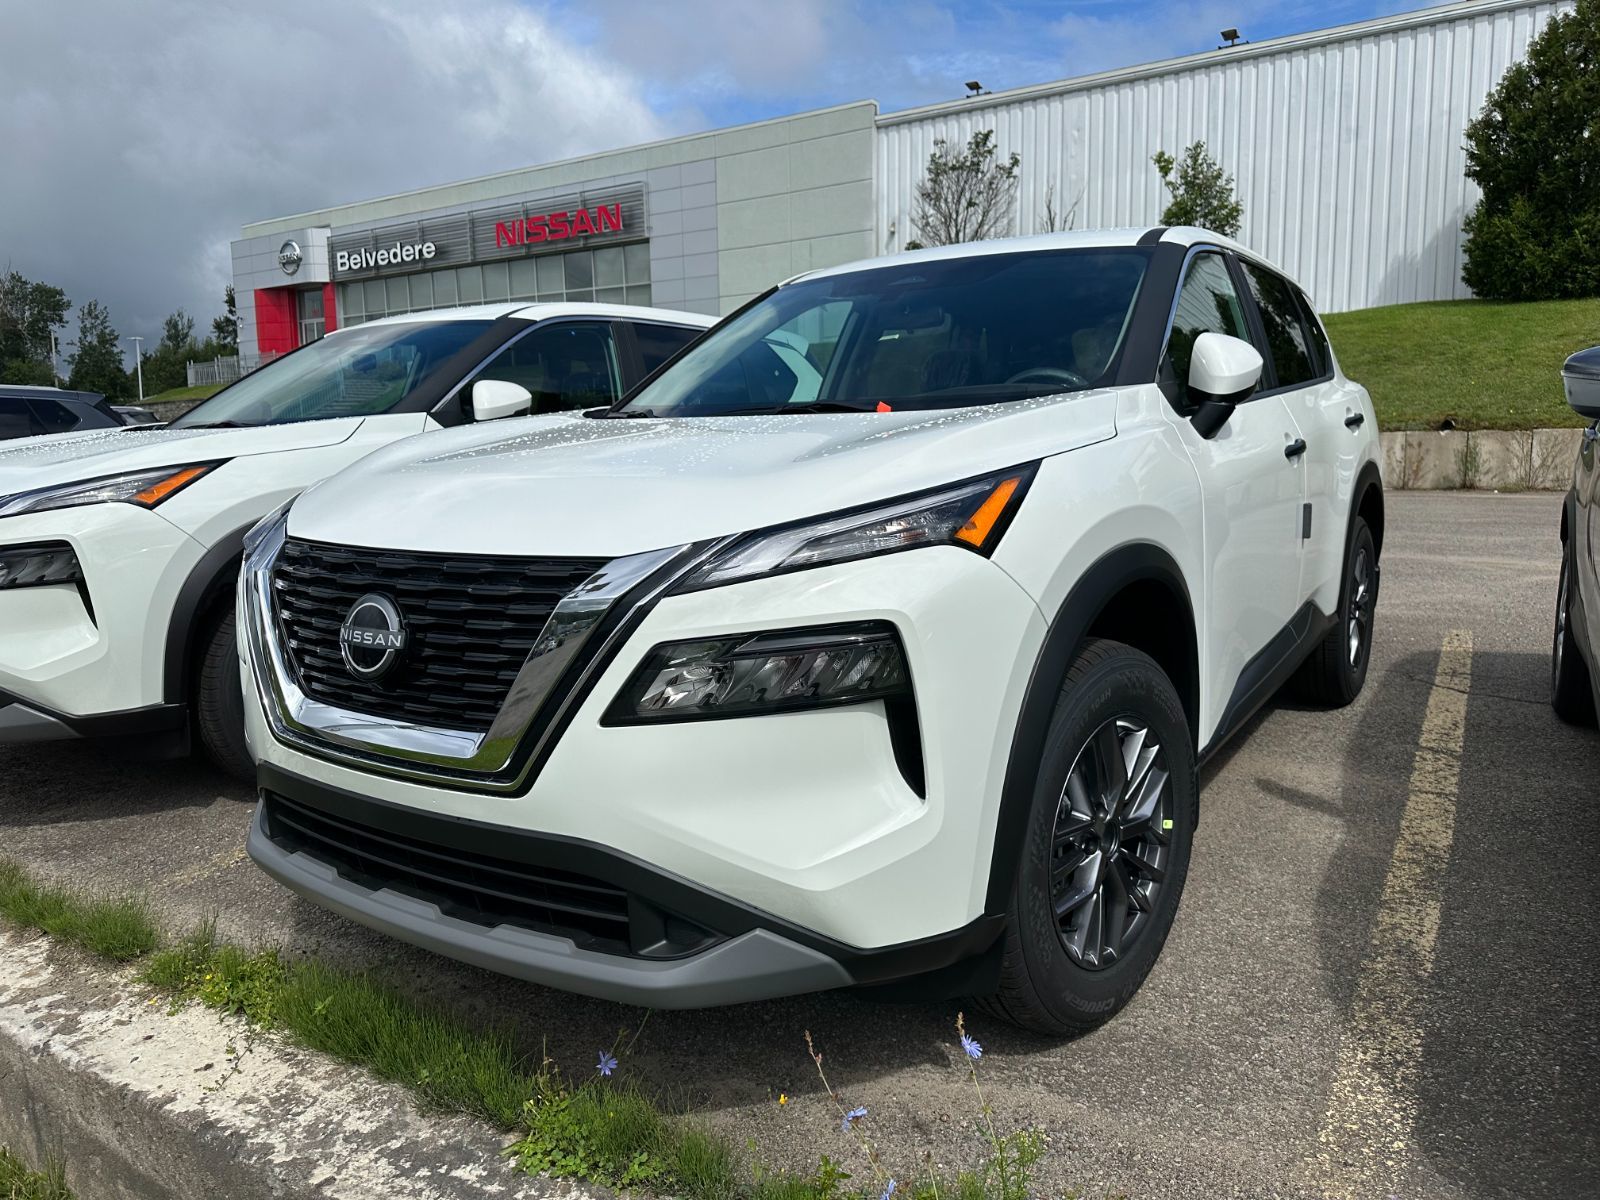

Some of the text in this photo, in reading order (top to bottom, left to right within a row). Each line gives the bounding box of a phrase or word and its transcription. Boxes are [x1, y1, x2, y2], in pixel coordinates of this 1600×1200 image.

[496, 204, 622, 247] NISSAN
[336, 240, 436, 273] Belvedere
[341, 628, 402, 647] NISSAN
